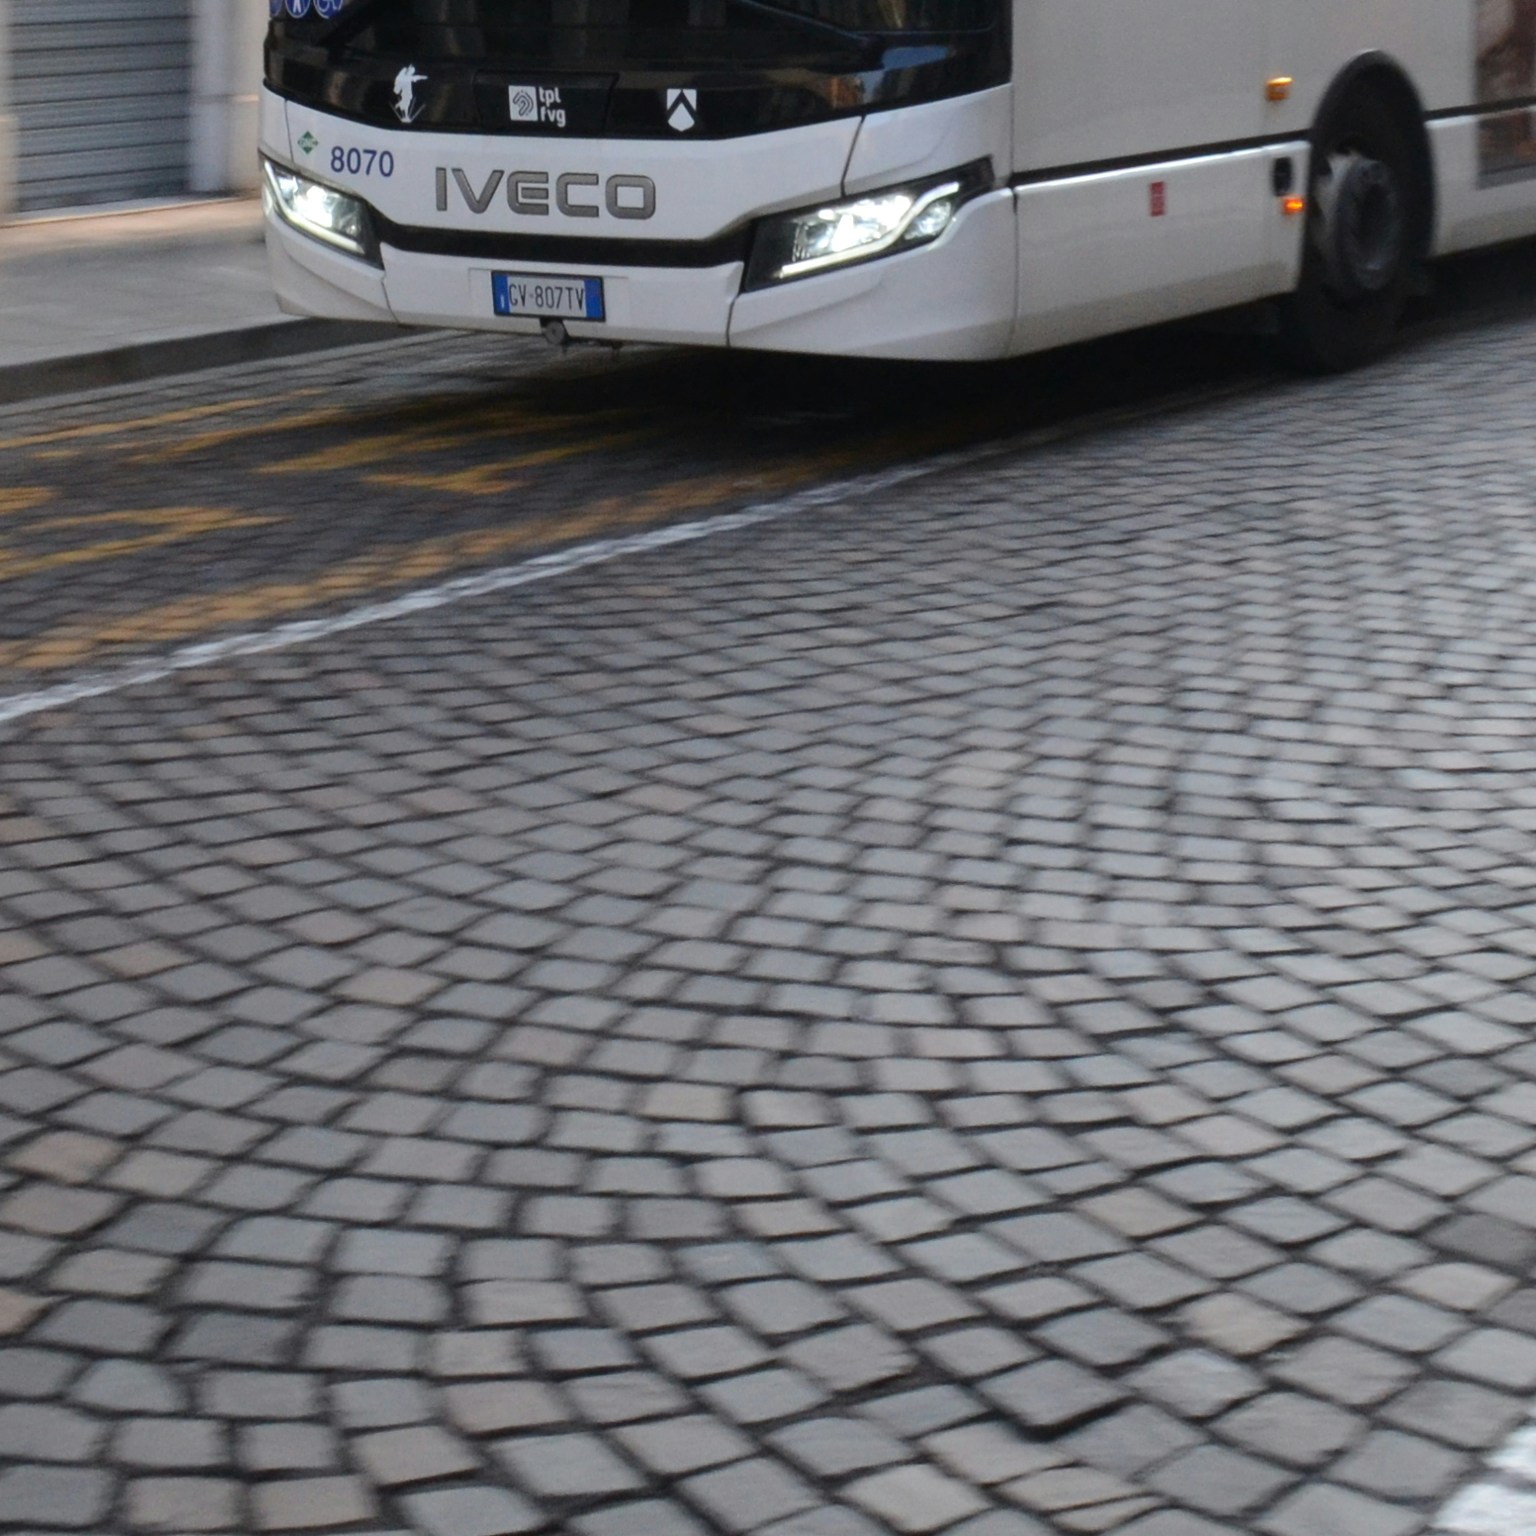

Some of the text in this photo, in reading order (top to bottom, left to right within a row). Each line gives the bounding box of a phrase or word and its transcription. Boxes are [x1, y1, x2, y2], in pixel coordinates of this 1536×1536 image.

[538, 86, 562, 107] tpl
[539, 106, 567, 128] fvg
[330, 146, 395, 178] 8070
[435, 166, 657, 220] IVECO
[534, 285, 585, 311] 807TV
